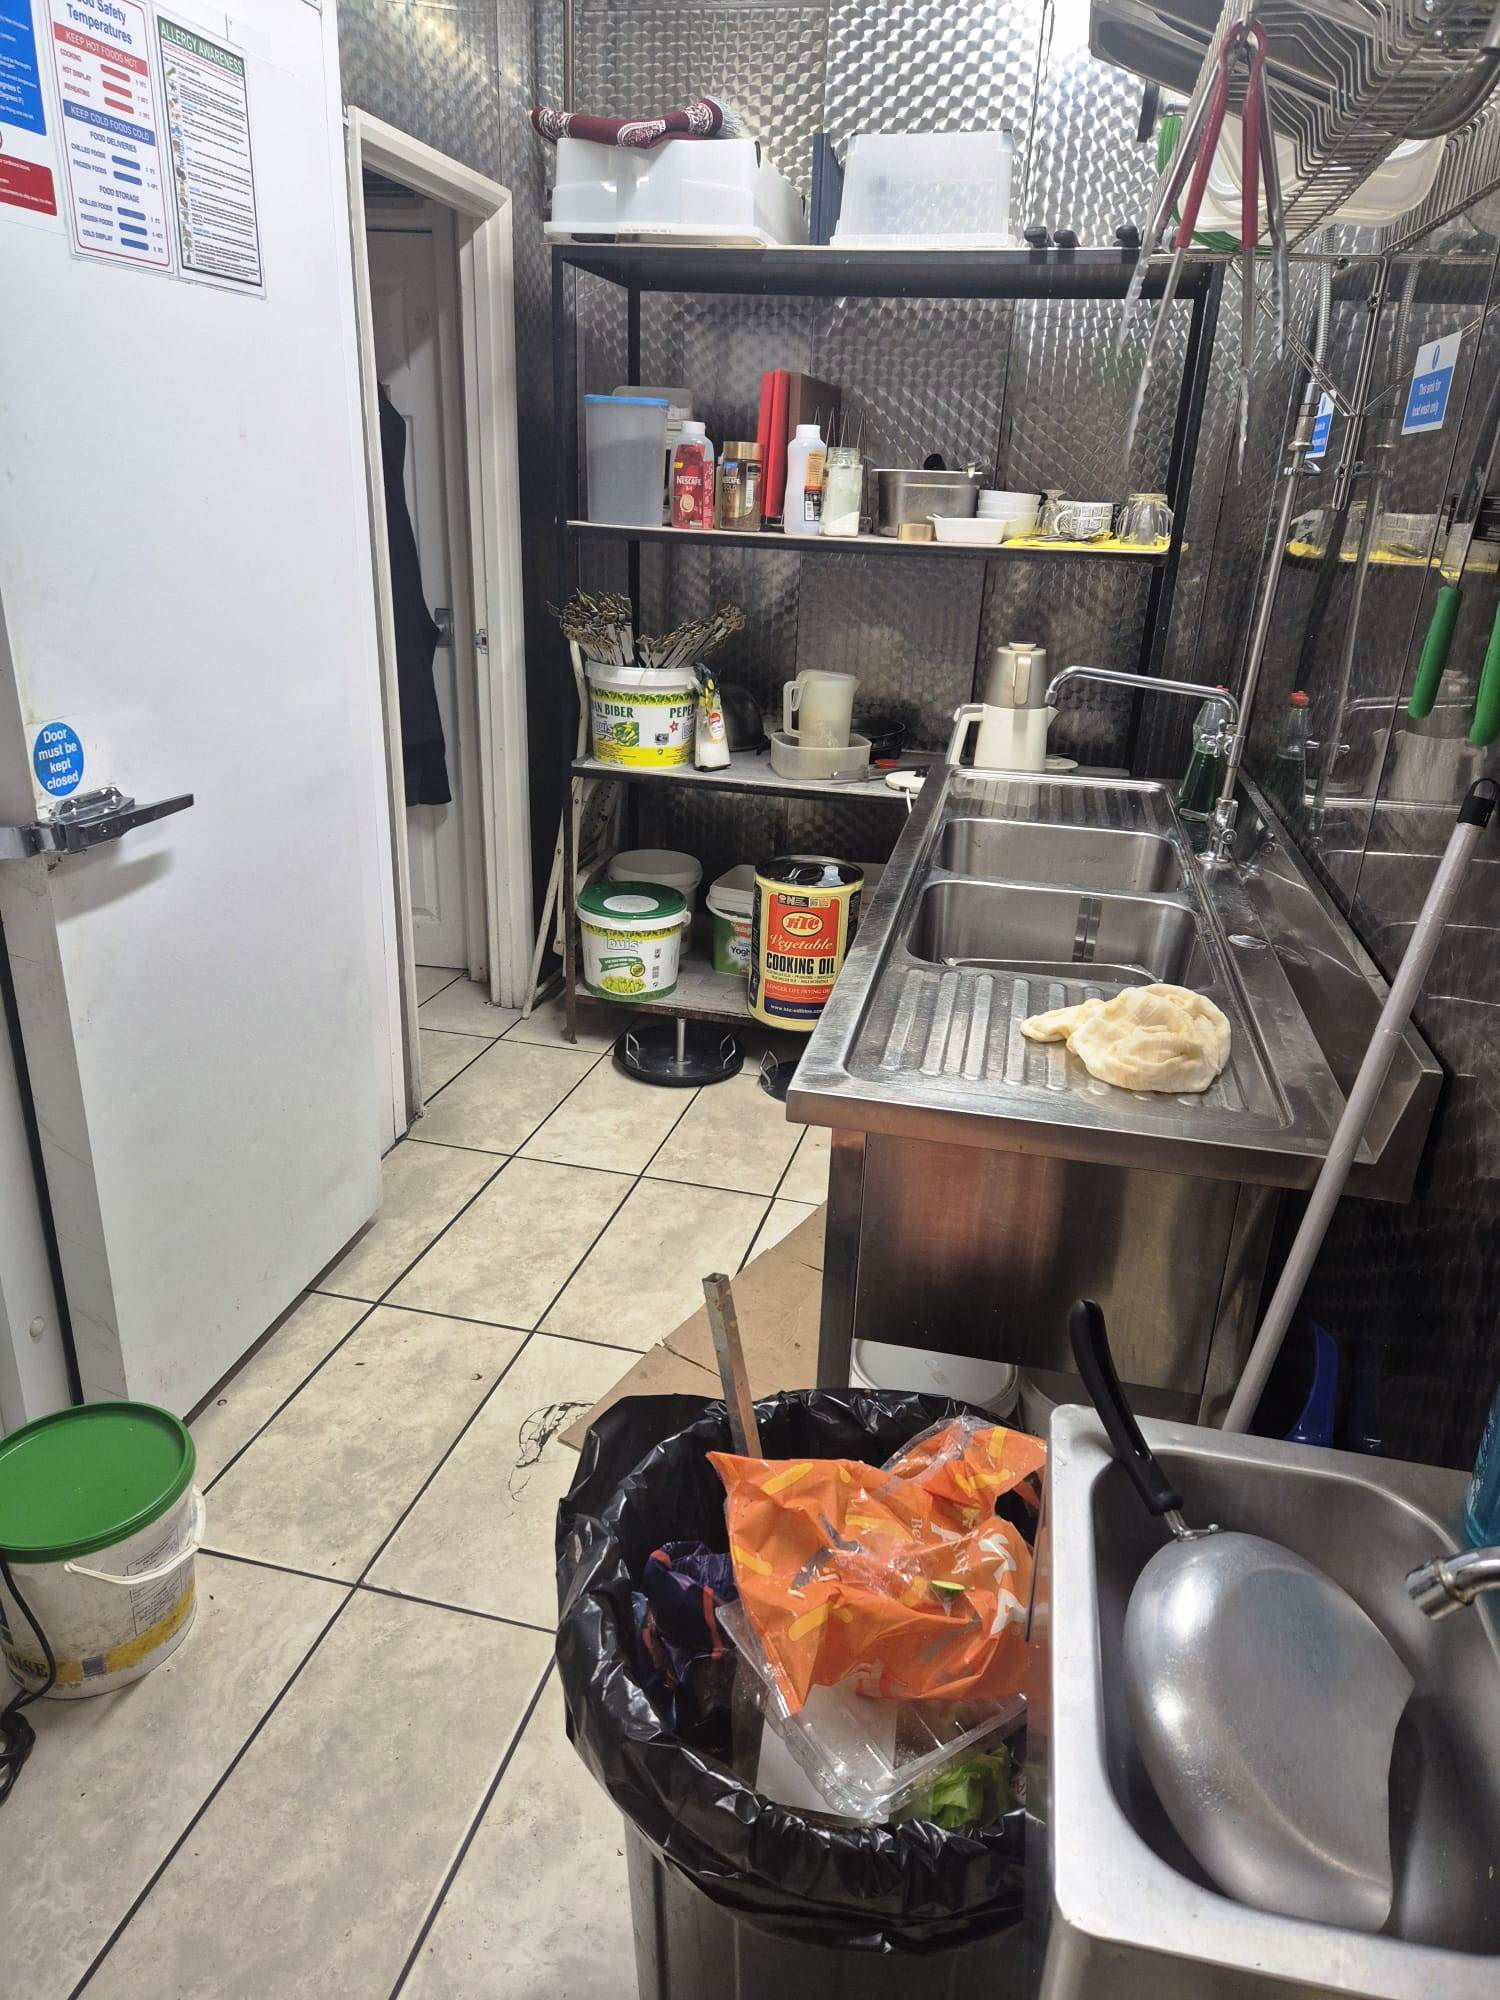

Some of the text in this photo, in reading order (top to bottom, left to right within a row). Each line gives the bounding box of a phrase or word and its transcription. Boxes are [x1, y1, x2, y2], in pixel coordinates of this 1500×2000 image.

[97, 0, 126, 25] Safety
[66, 3, 132, 45] Temperatures
[66, 31, 137, 68] KEEP HOT FOODS HOT
[160, 22, 198, 53] ALLERGY
[199, 42, 243, 74] AWARENESS
[70, 105, 150, 141] KEEP COLD FOODS COLD
[89, 130, 137, 153] FOOD DELIVERIES
[98, 185, 140, 203] FOOD STORAGE
[605, 703, 634, 718] BIBER
[43, 729, 68, 744] Door
[38, 742, 78, 760] must be
[49, 758, 72, 774] kept
[46, 770, 79, 790] closed
[769, 934, 833, 952] Vegetable
[766, 952, 836, 975] COOKING OIL
